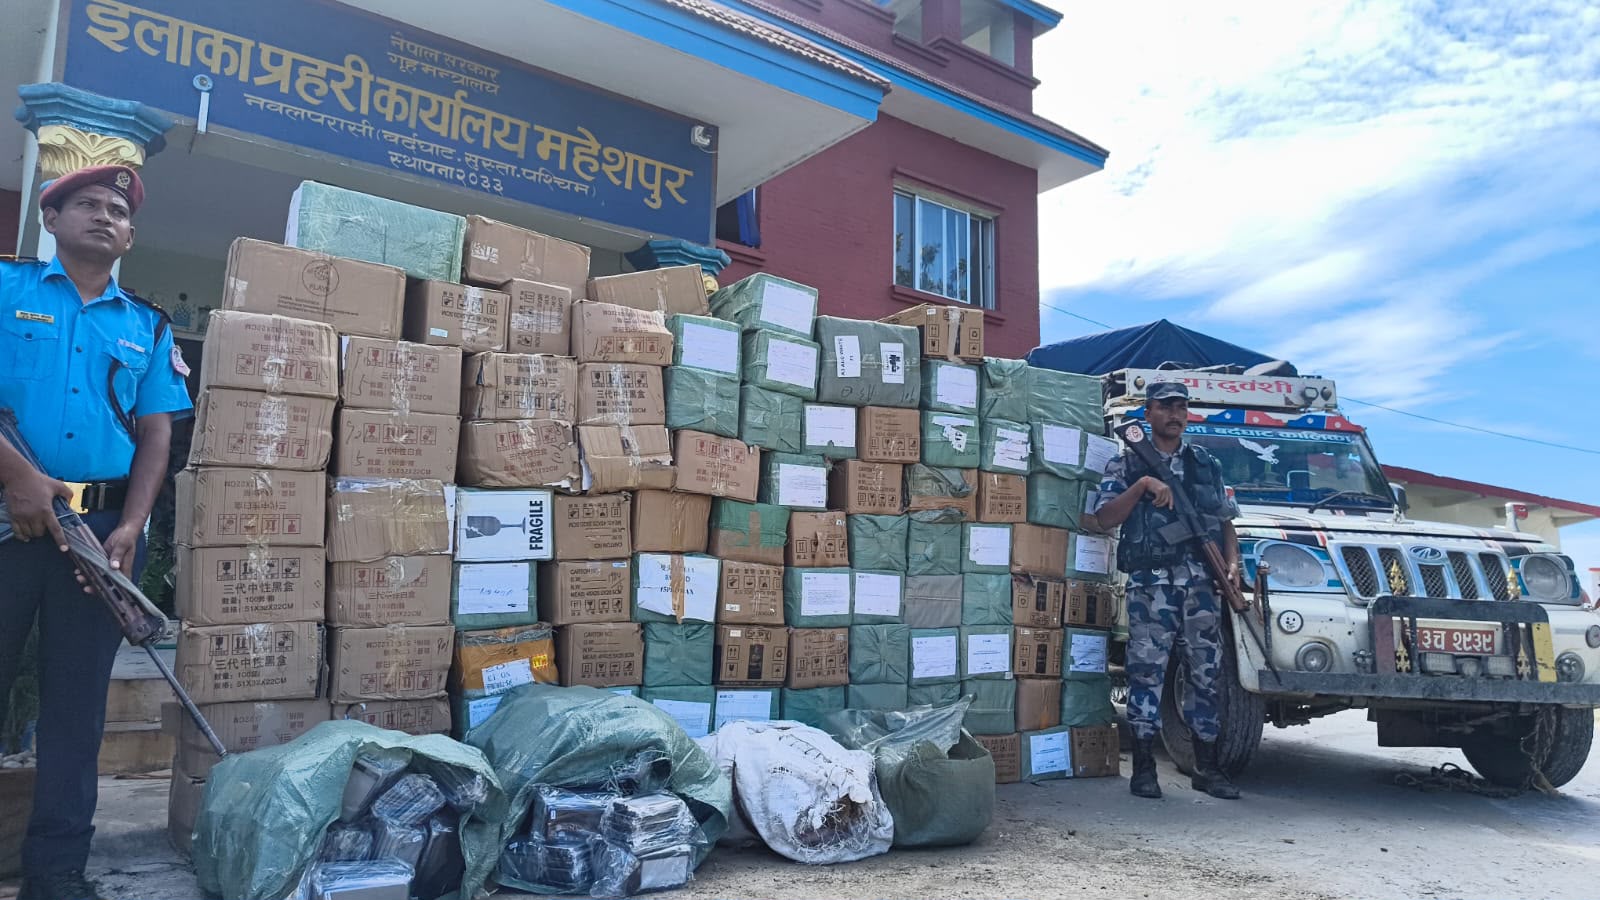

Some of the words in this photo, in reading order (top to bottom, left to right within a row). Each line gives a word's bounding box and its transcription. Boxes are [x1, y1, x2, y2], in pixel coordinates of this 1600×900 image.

[386, 51, 418, 74] गृह
[390, 31, 441, 63] नेपाल
[442, 53, 500, 84] सरकार
[86, 0, 254, 83] इलाका
[254, 43, 376, 117] प्रहरी
[373, 77, 530, 160] कार्यालय
[533, 125, 694, 210] महेशपुर
[243, 92, 376, 139] नवलपरासी
[529, 500, 544, 550] FRAGILE
